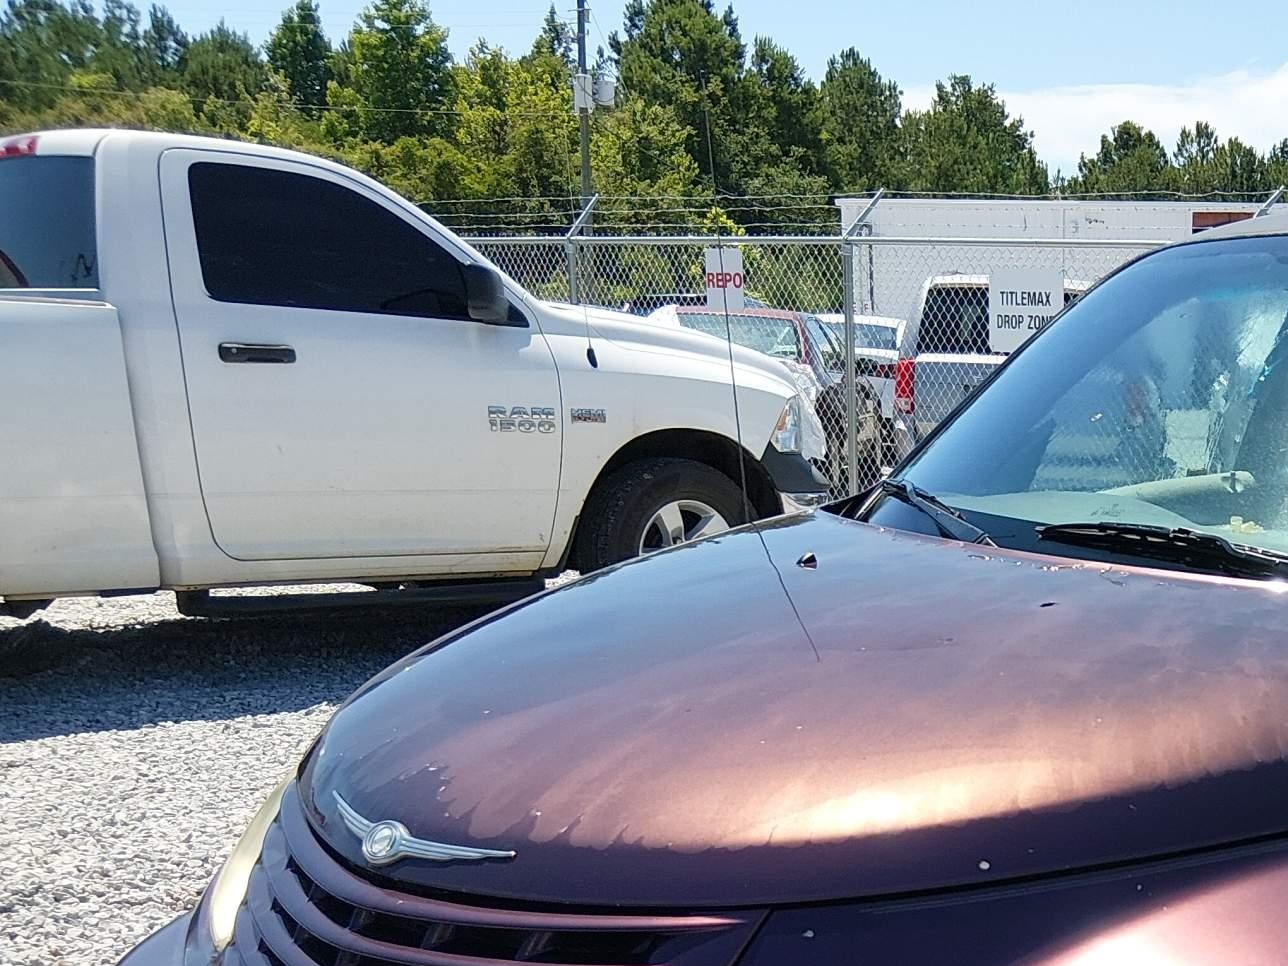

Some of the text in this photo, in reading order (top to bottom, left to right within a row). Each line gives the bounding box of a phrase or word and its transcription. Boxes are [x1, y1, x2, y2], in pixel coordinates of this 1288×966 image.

[706, 272, 743, 289] REPO
[999, 291, 1052, 307] TITLEMAX
[996, 314, 1024, 329] DROP
[487, 405, 555, 420] RAM
[488, 419, 556, 433] 1500
